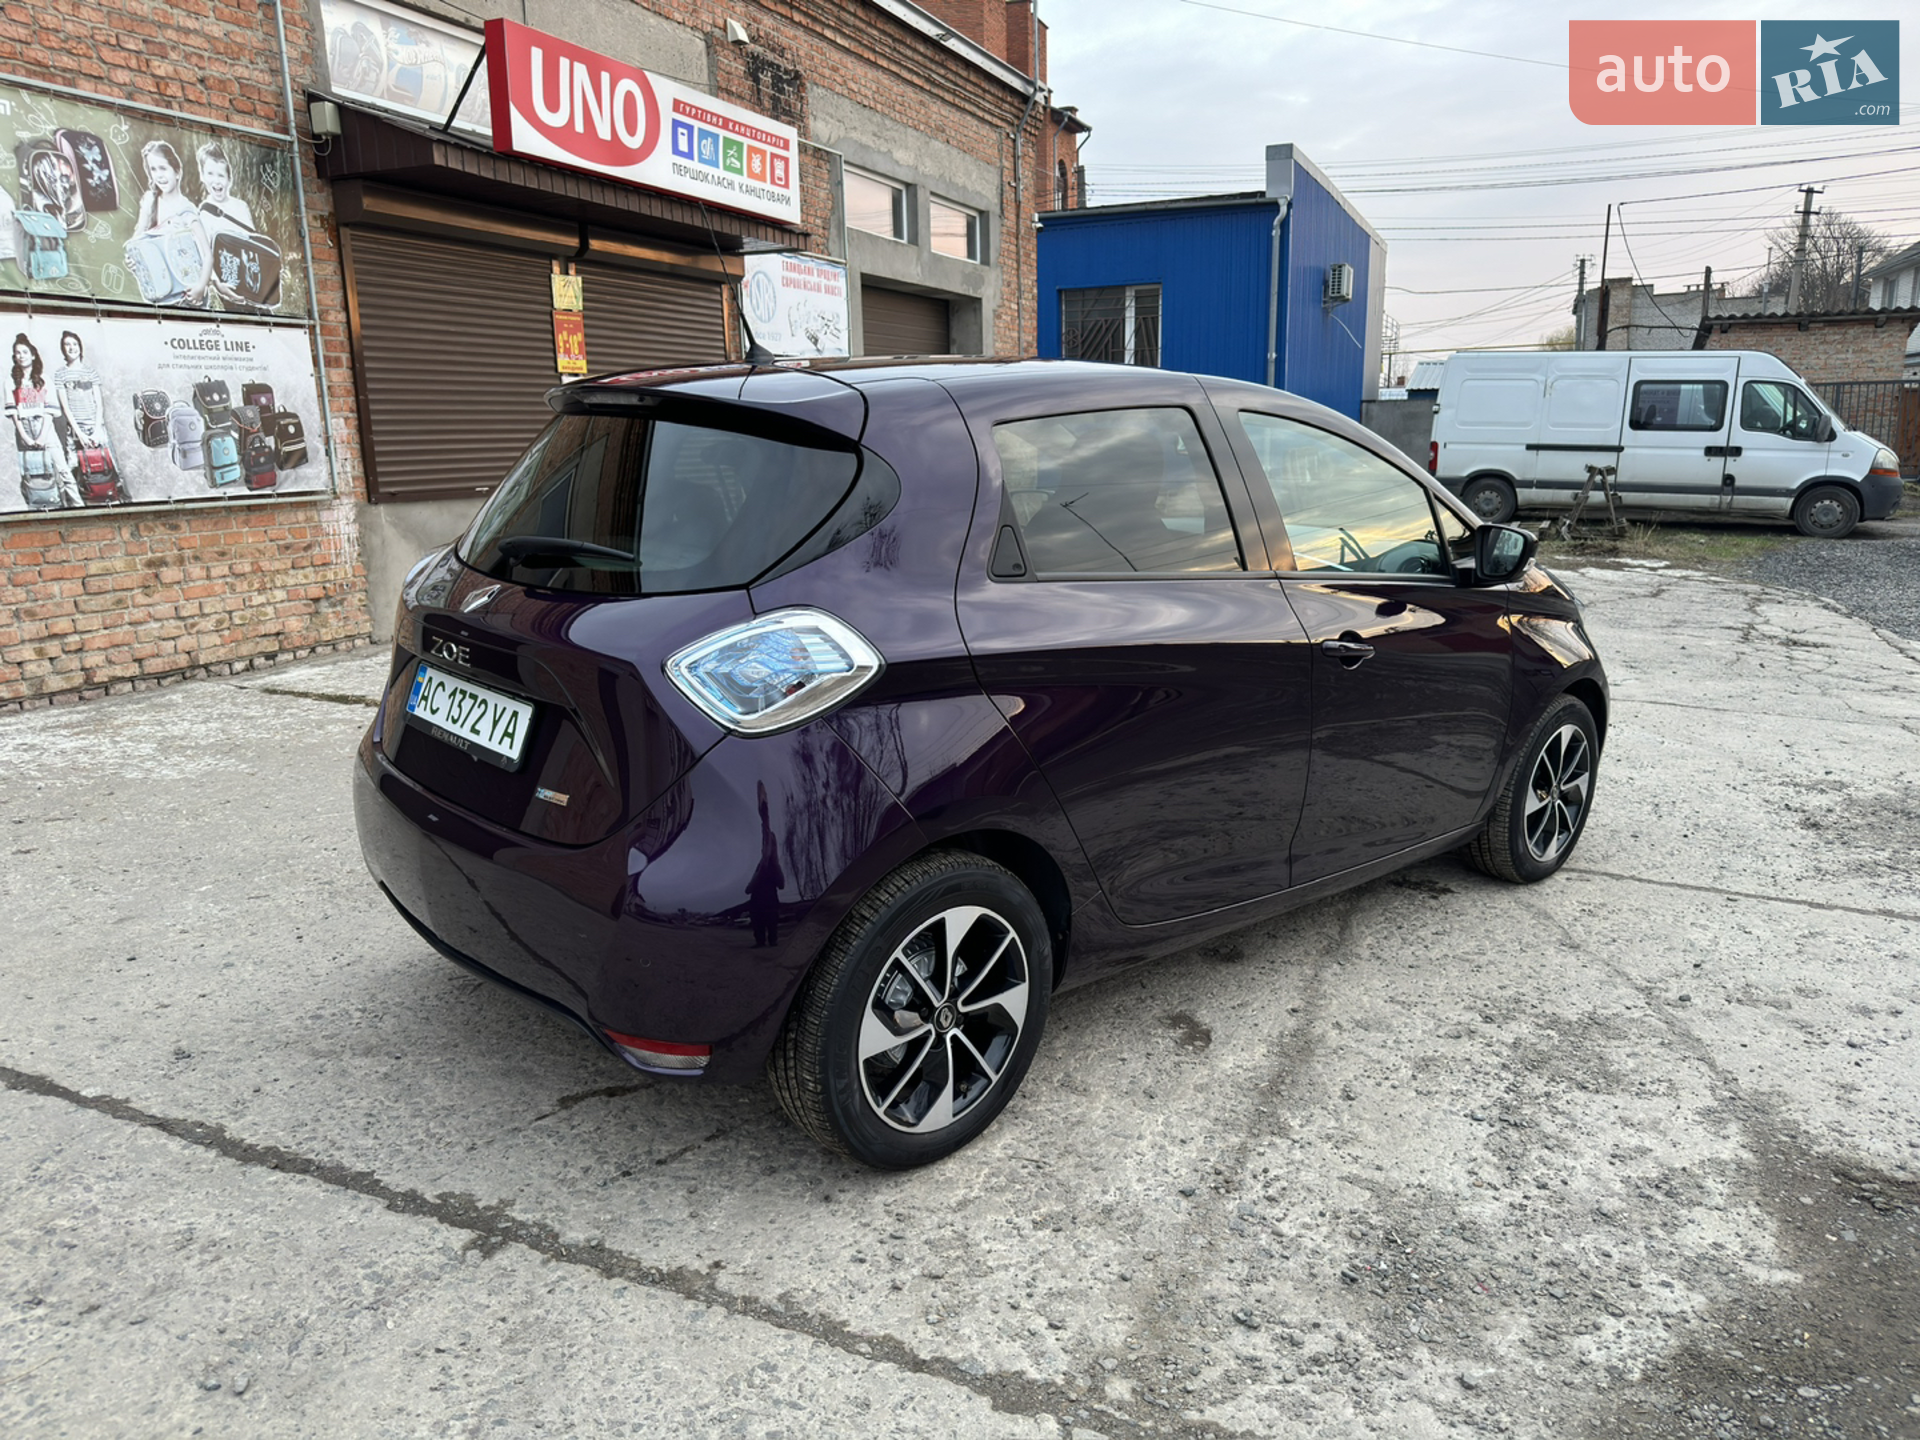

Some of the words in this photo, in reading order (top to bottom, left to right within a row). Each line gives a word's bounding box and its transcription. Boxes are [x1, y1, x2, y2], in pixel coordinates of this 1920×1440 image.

[530, 45, 646, 150] UNO
[679, 102, 724, 126] ГУРТІВНЯ
[728, 121, 785, 148] КАНЦТОВАРІВ
[671, 162, 736, 191] ПЕРШОКЛАСНІ
[738, 182, 792, 207] КАНЦТОВАРИ
[170, 338, 221, 351] COLLEGE
[223, 340, 251, 353] LINE
[430, 635, 471, 668] ZOE
[416, 675, 446, 716] AC
[446, 686, 489, 737] 1372
[488, 702, 519, 750] YA
[430, 726, 471, 751] RENAULT
